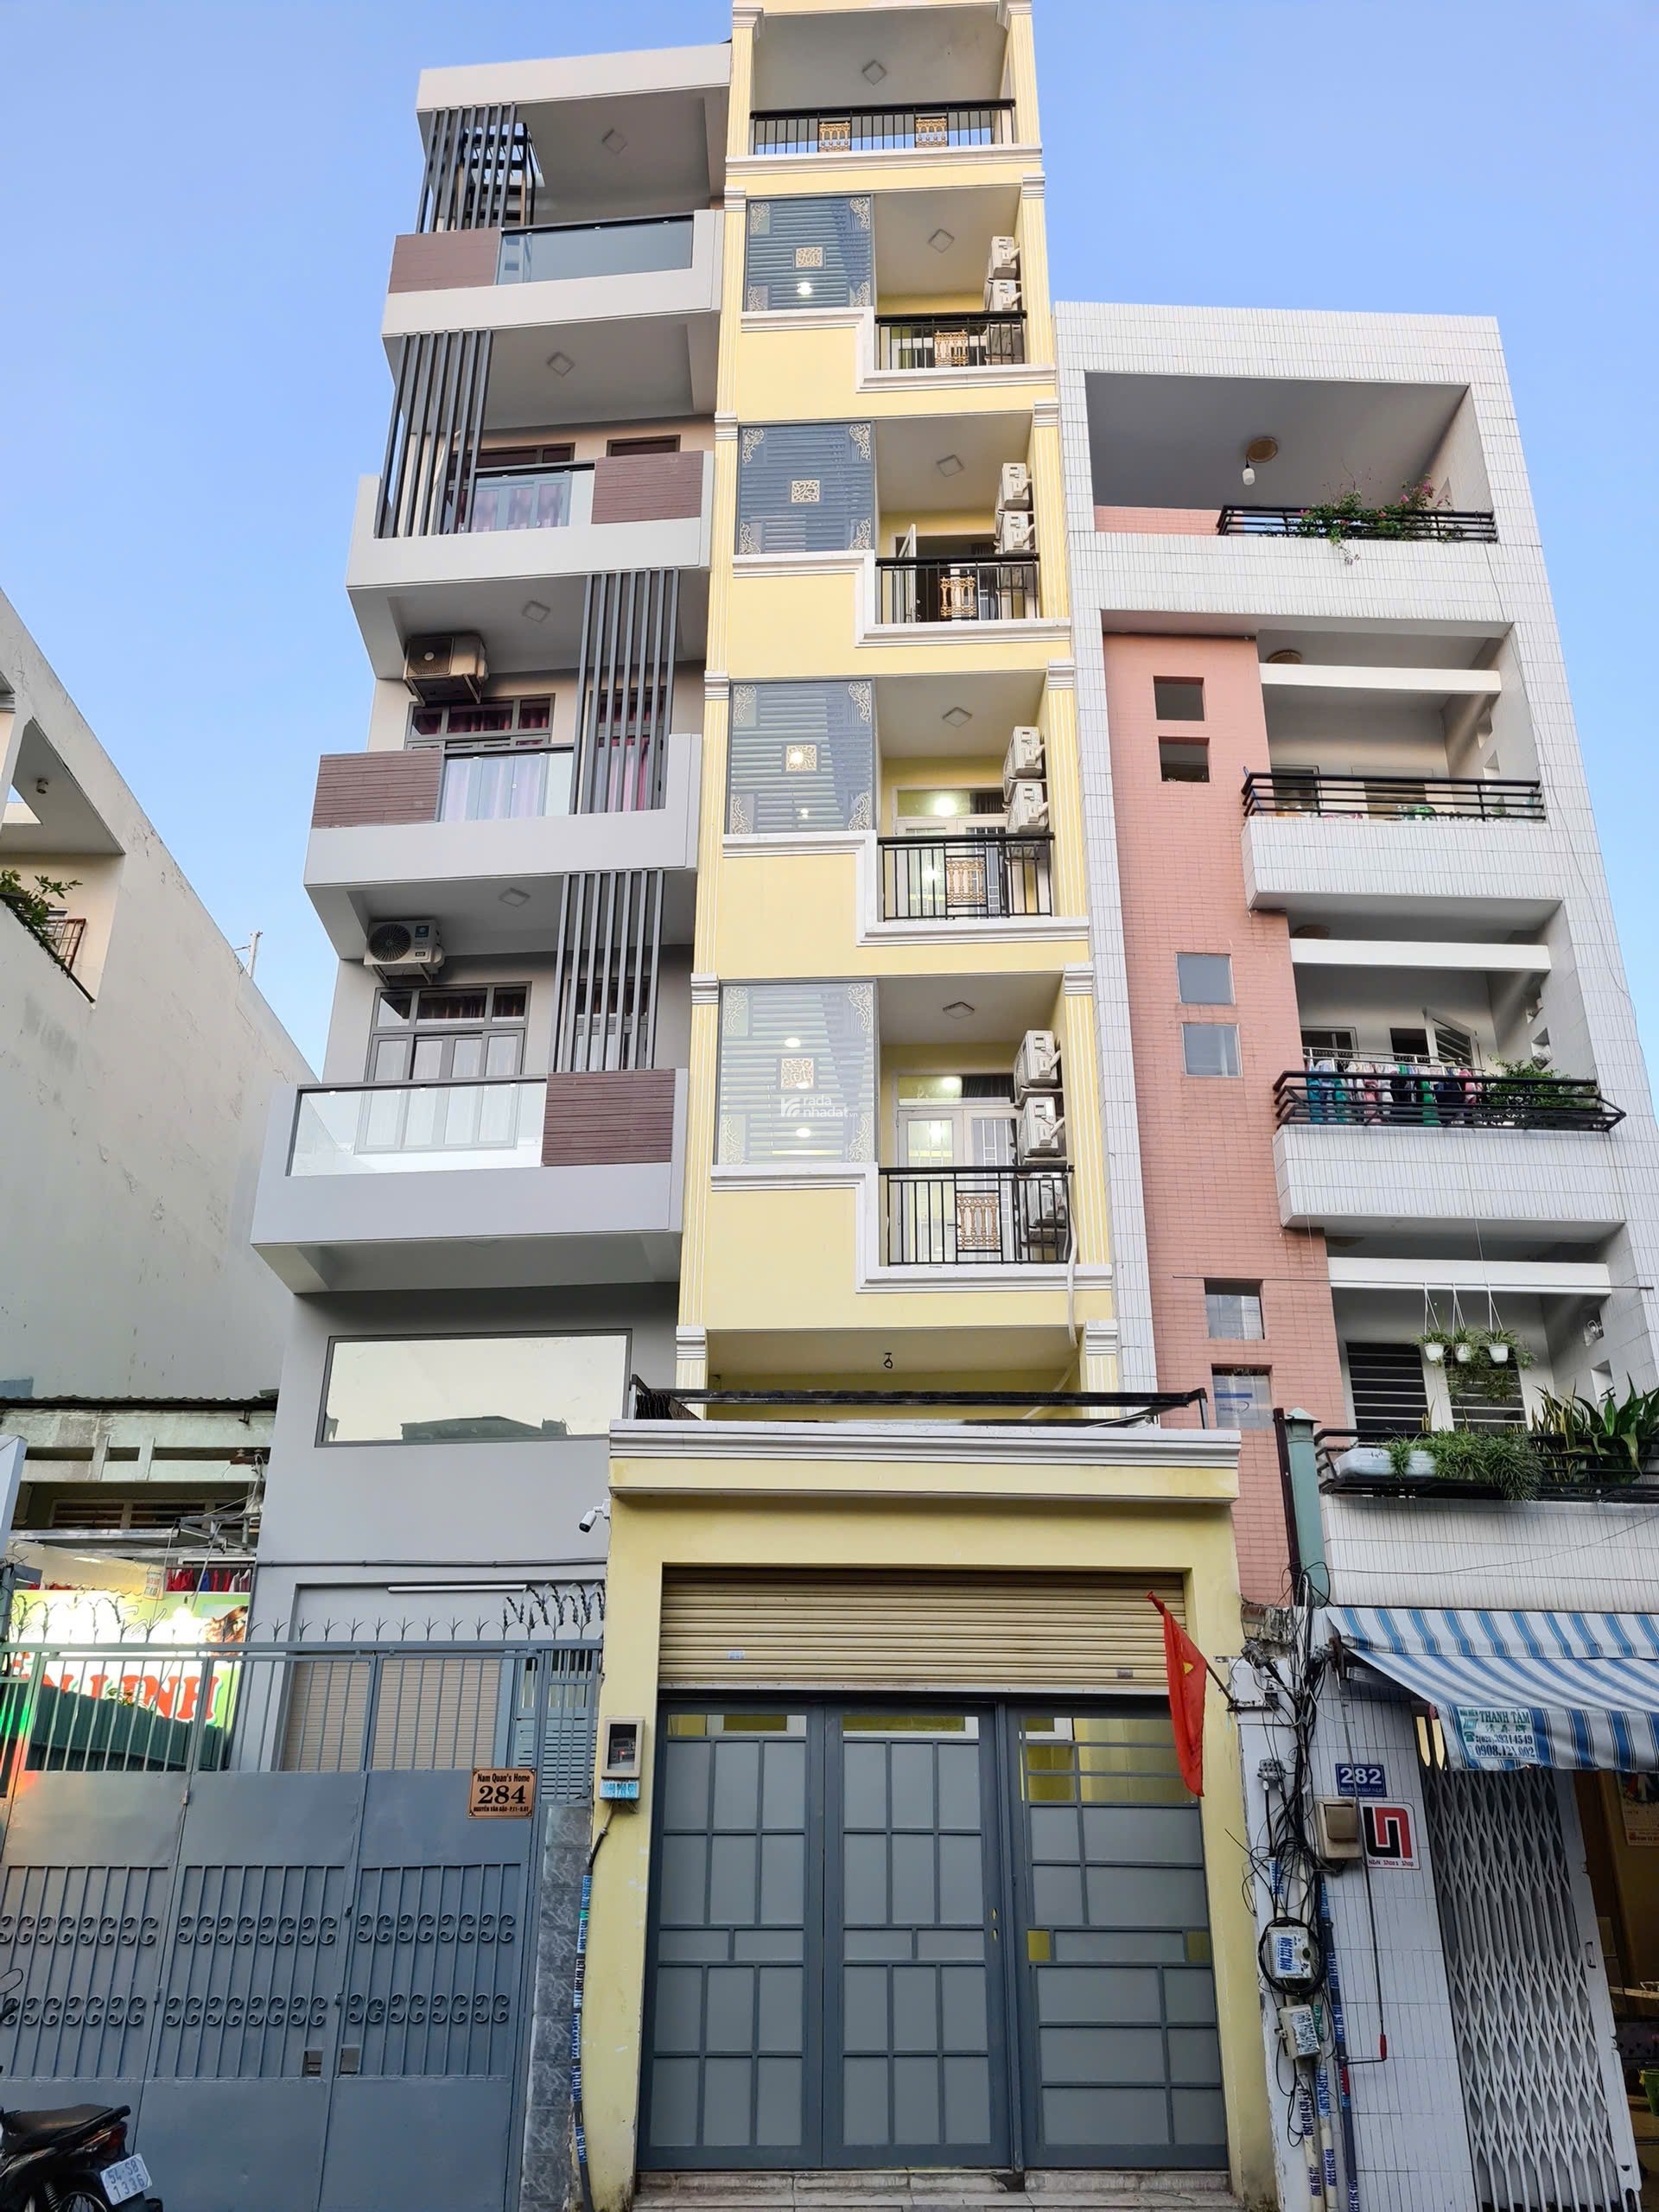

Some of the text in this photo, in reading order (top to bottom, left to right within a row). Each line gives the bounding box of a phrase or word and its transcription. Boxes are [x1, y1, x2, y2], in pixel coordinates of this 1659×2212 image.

[1479, 1711, 1510, 1724] THANH
[477, 1773, 531, 1783] Nam Quan's Home
[1340, 1767, 1382, 1784] 282
[478, 1785, 526, 1804] 284
[113, 2174, 144, 2199] 1336
